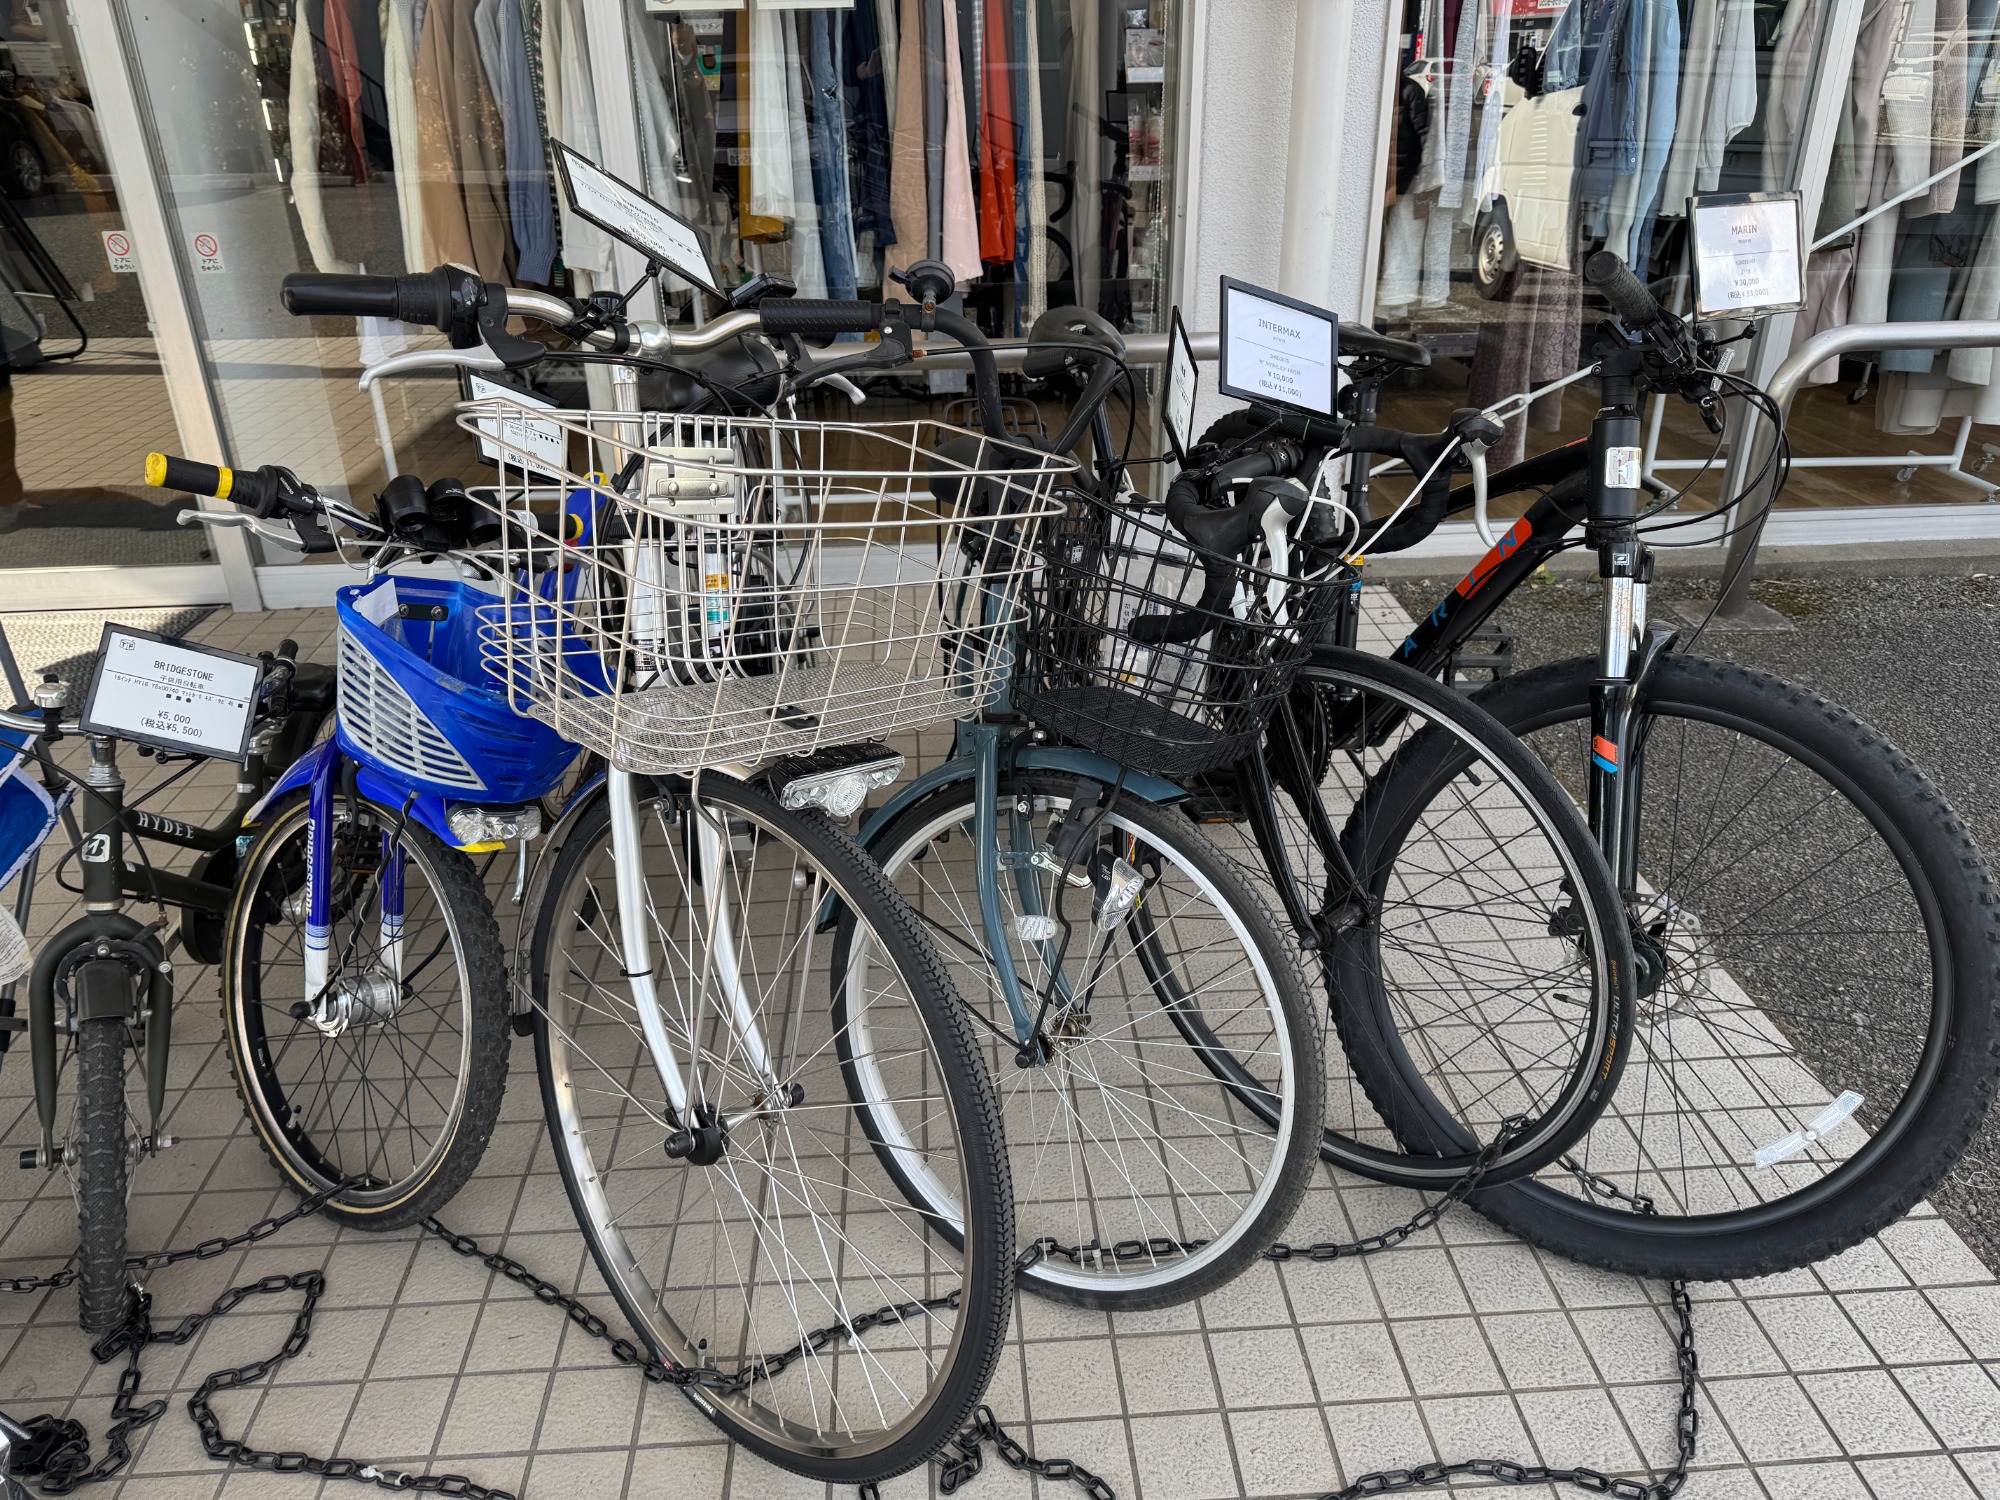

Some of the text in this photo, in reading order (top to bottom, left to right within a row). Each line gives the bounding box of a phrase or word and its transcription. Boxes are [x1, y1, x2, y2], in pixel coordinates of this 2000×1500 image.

[1731, 225, 1758, 236] MARIN
[1258, 318, 1301, 339] INTERMAX
[153, 660, 214, 682] BRIDGESTONE
[140, 717, 203, 738] (税込¥5,500)
[157, 709, 191, 725] ¥5,000
[137, 811, 195, 839] HYDEE
